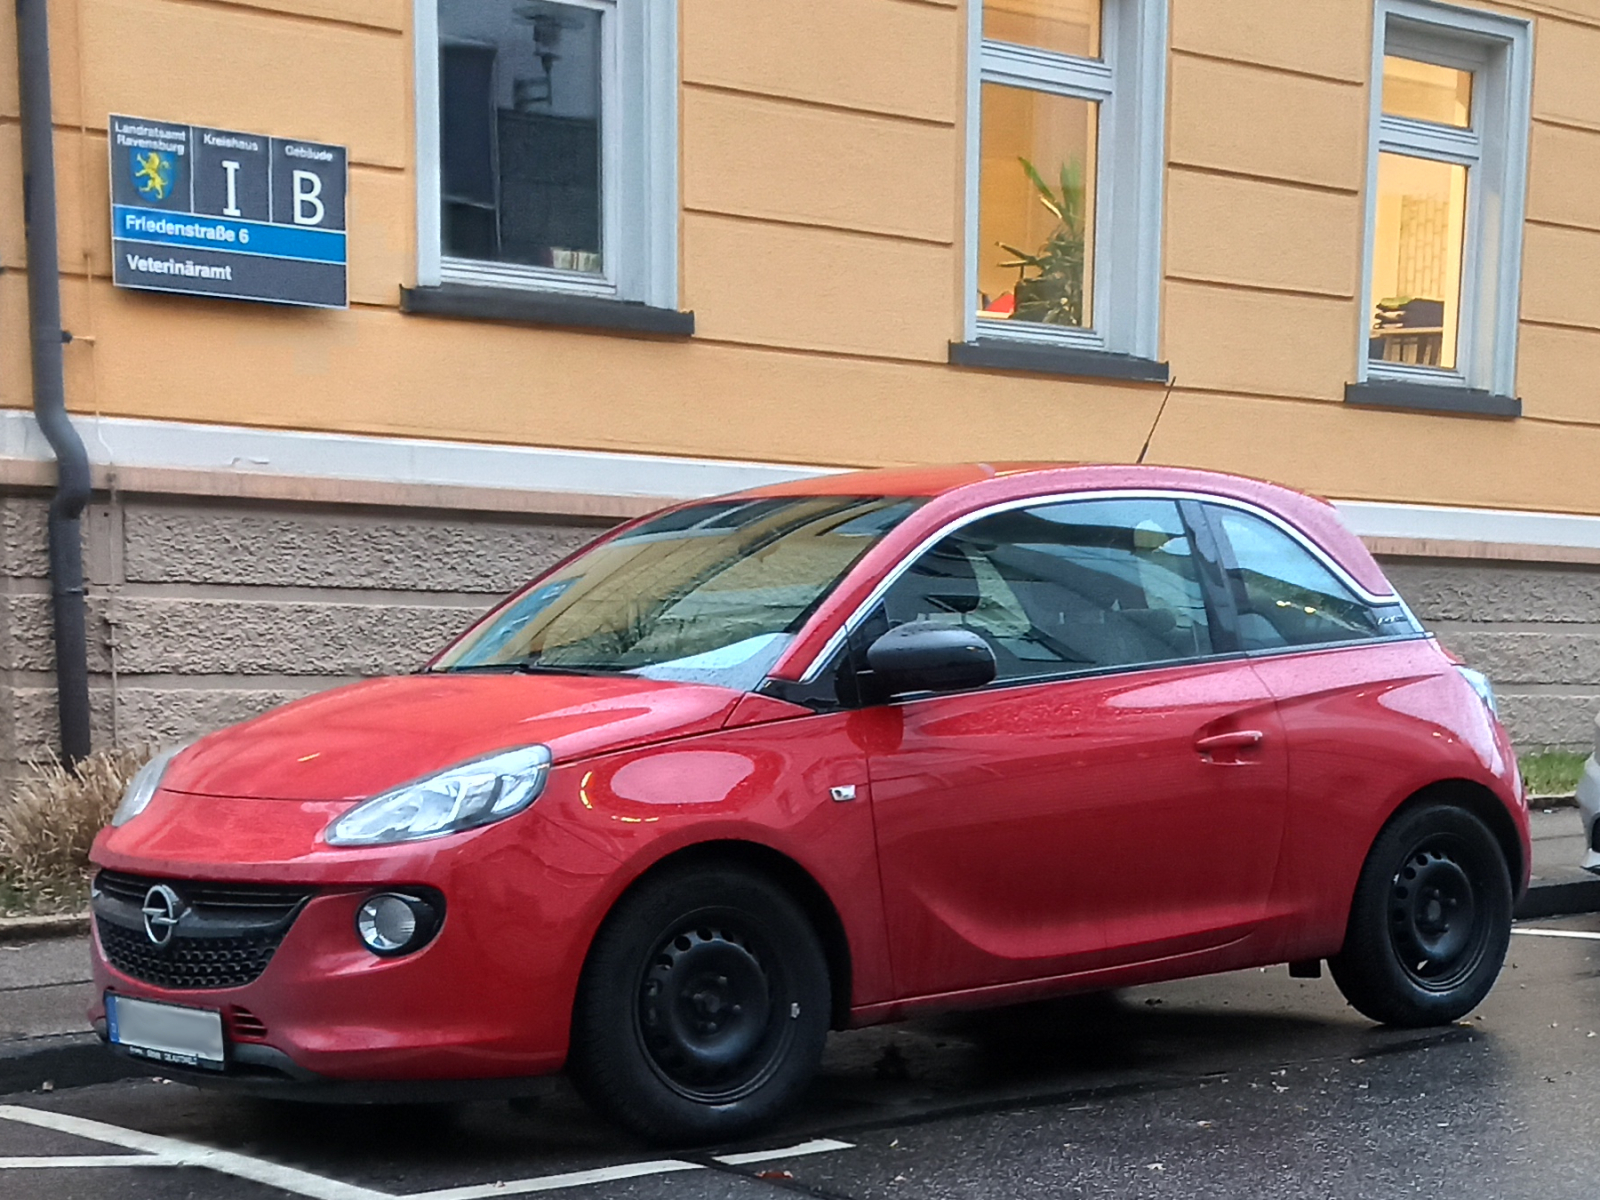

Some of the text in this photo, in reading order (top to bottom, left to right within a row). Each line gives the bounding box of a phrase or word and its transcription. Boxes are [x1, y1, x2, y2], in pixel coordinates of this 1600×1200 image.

[115, 121, 186, 142] Landratsamt
[116, 134, 185, 155] Ravensburg
[203, 133, 259, 152] Kreishaus
[285, 145, 334, 162] Gebäude
[292, 169, 325, 226] B
[125, 214, 250, 244] Friedenstraße 6
[126, 253, 233, 281] Veterinäramt
